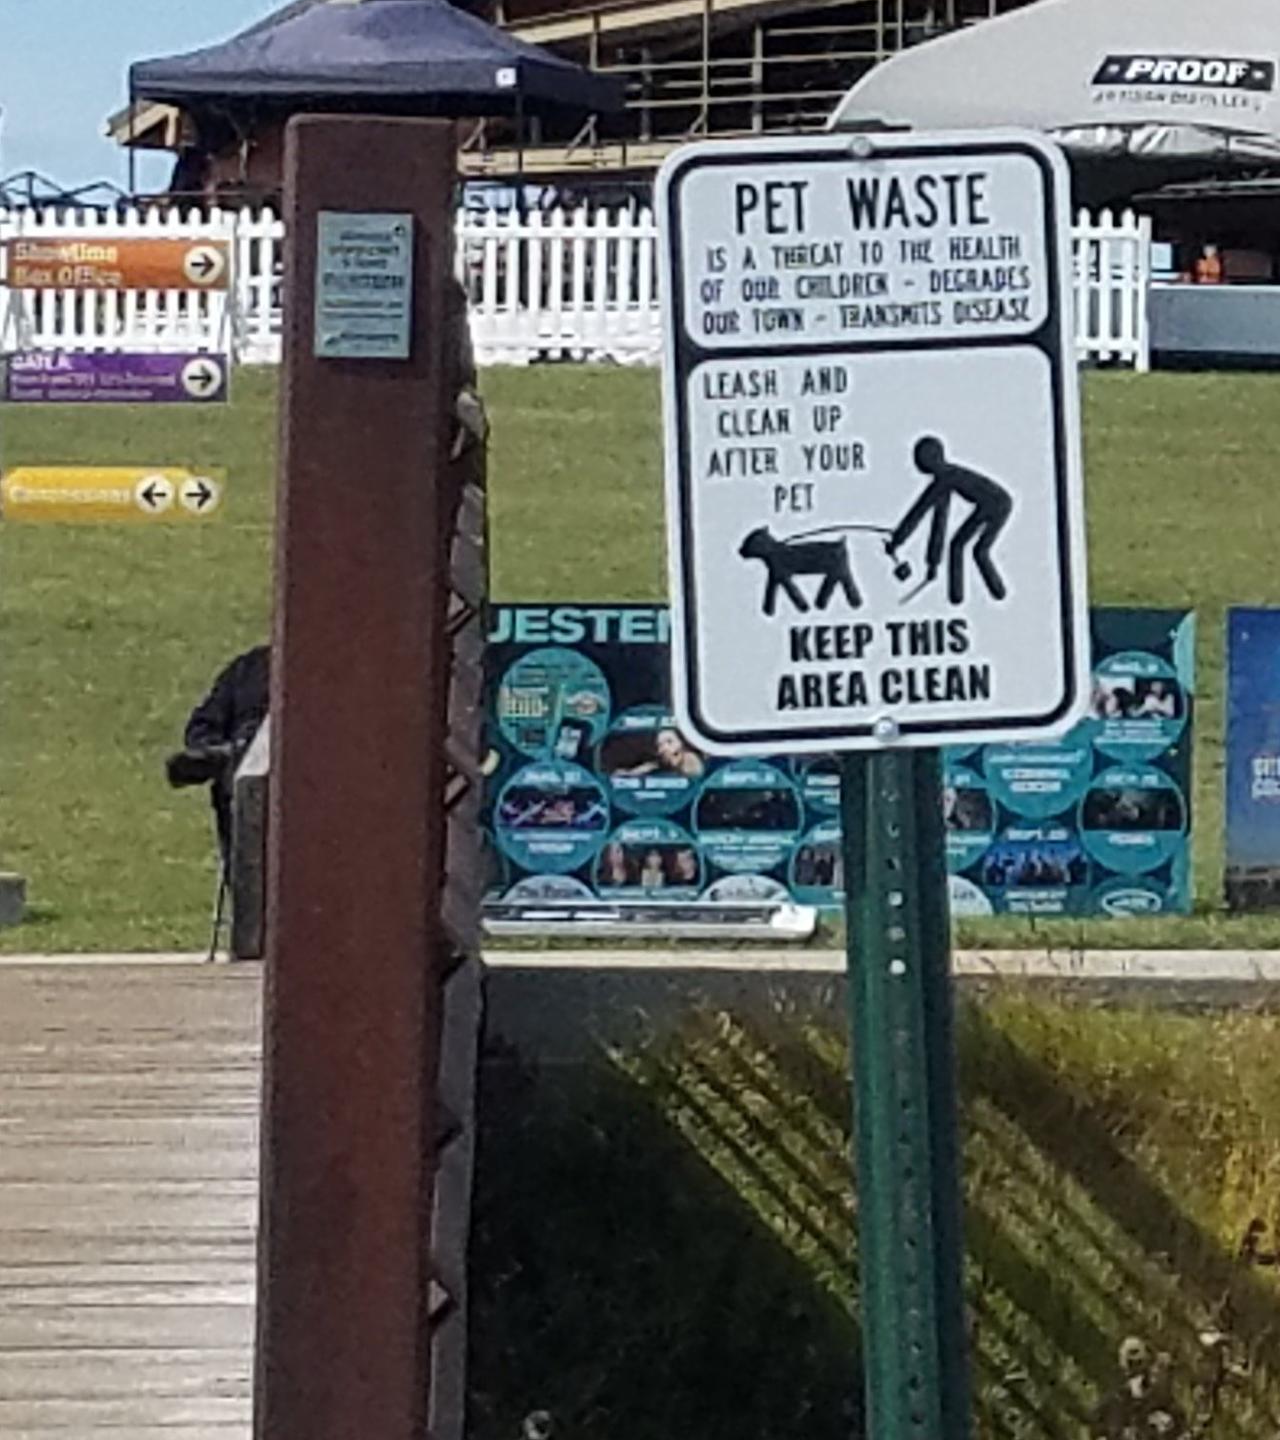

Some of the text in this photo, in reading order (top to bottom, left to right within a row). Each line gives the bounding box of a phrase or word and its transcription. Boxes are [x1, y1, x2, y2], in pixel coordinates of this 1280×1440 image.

[1124, 60, 1250, 84] PROOF
[735, 172, 990, 234] PET WASTE
[706, 234, 1022, 272] IS A THREAT TO THE HEALTH
[700, 278, 724, 304] OF
[742, 276, 780, 302] OUR
[795, 272, 889, 299] CHILDREN
[929, 265, 1032, 293] DEGRADES
[702, 310, 739, 335] OUR
[753, 308, 805, 333] TOWN
[838, 301, 942, 328] TRANSMITS
[953, 297, 1032, 324] DISEASE
[703, 366, 848, 400] LEASH AND
[718, 405, 842, 438] CLEAN UP
[706, 443, 865, 477] AFTER YOUR
[774, 483, 815, 513] PET
[789, 619, 970, 662] KEEP THIS
[776, 664, 991, 711] AREA CLEAN
